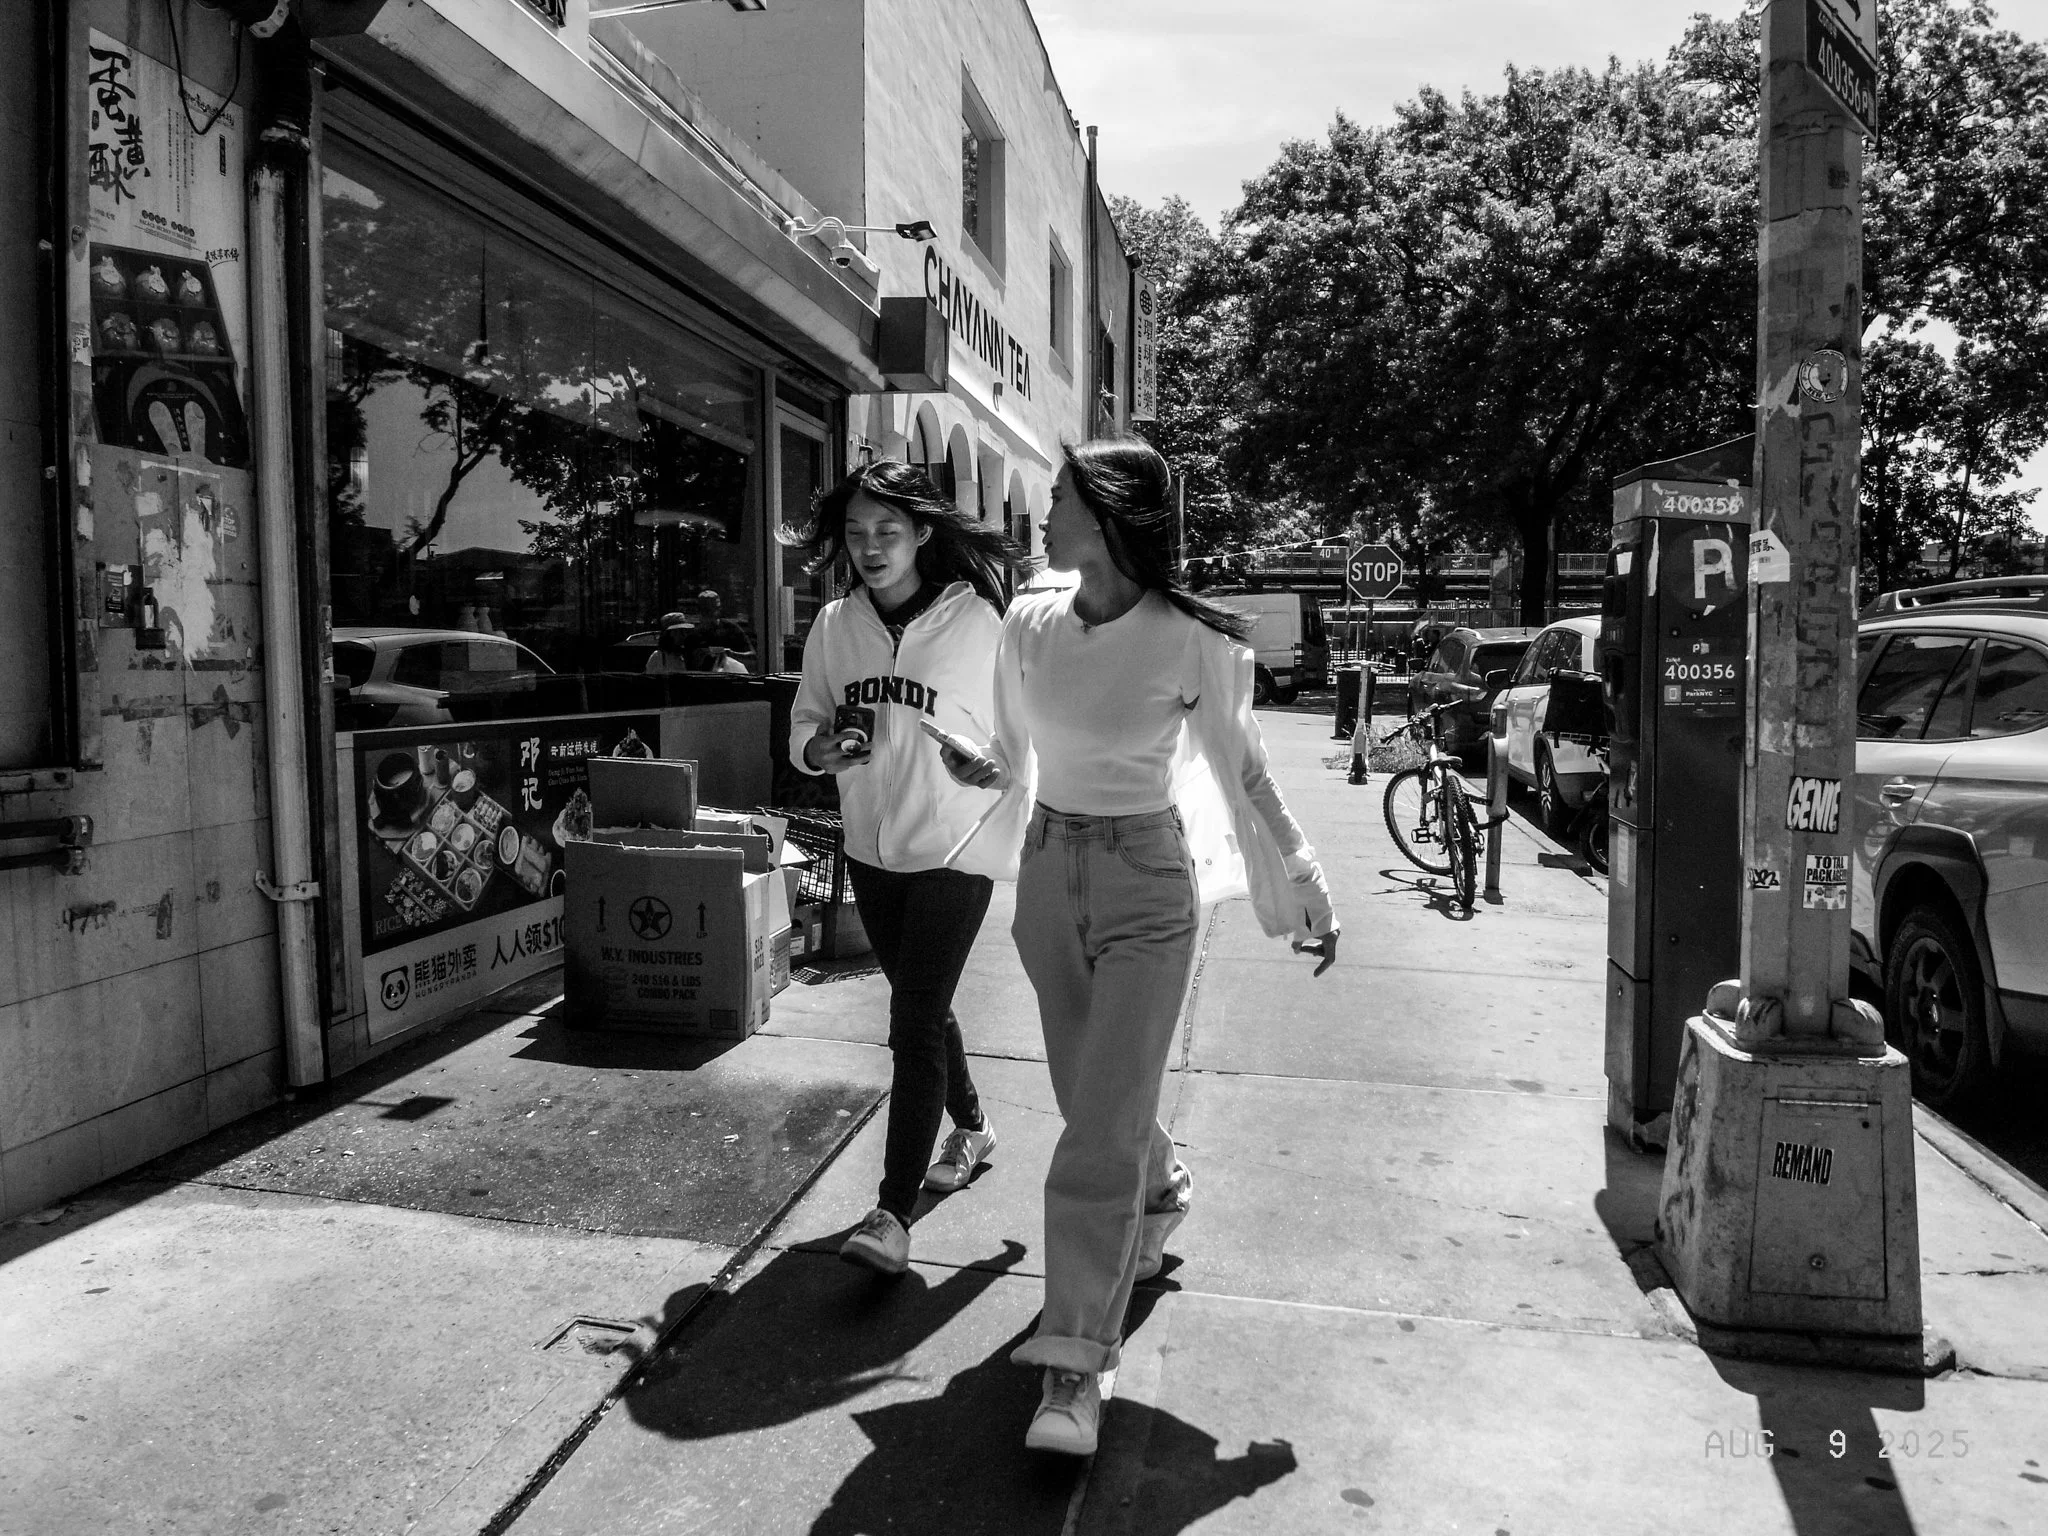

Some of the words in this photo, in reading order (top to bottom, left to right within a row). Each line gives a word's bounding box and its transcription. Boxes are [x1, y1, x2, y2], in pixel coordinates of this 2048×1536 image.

[1818, 36, 1861, 114] 400356
[924, 244, 1004, 378] CHAYANN
[1008, 334, 1032, 402] TEA
[1663, 495, 1740, 515] 400356
[1319, 548, 1331, 559] 40
[1351, 561, 1399, 582] STOP
[1664, 664, 1735, 680] 400356
[844, 676, 938, 717] BONDI
[1786, 776, 1841, 833] GENIE
[696, 931, 708, 939] UP
[414, 944, 477, 989] 熊猫外卖
[628, 949, 704, 966] INDUSTRIES
[631, 974, 649, 985] 240
[682, 976, 702, 987] LIDS
[638, 987, 671, 1000] COMBO
[672, 988, 698, 1001] PACK
